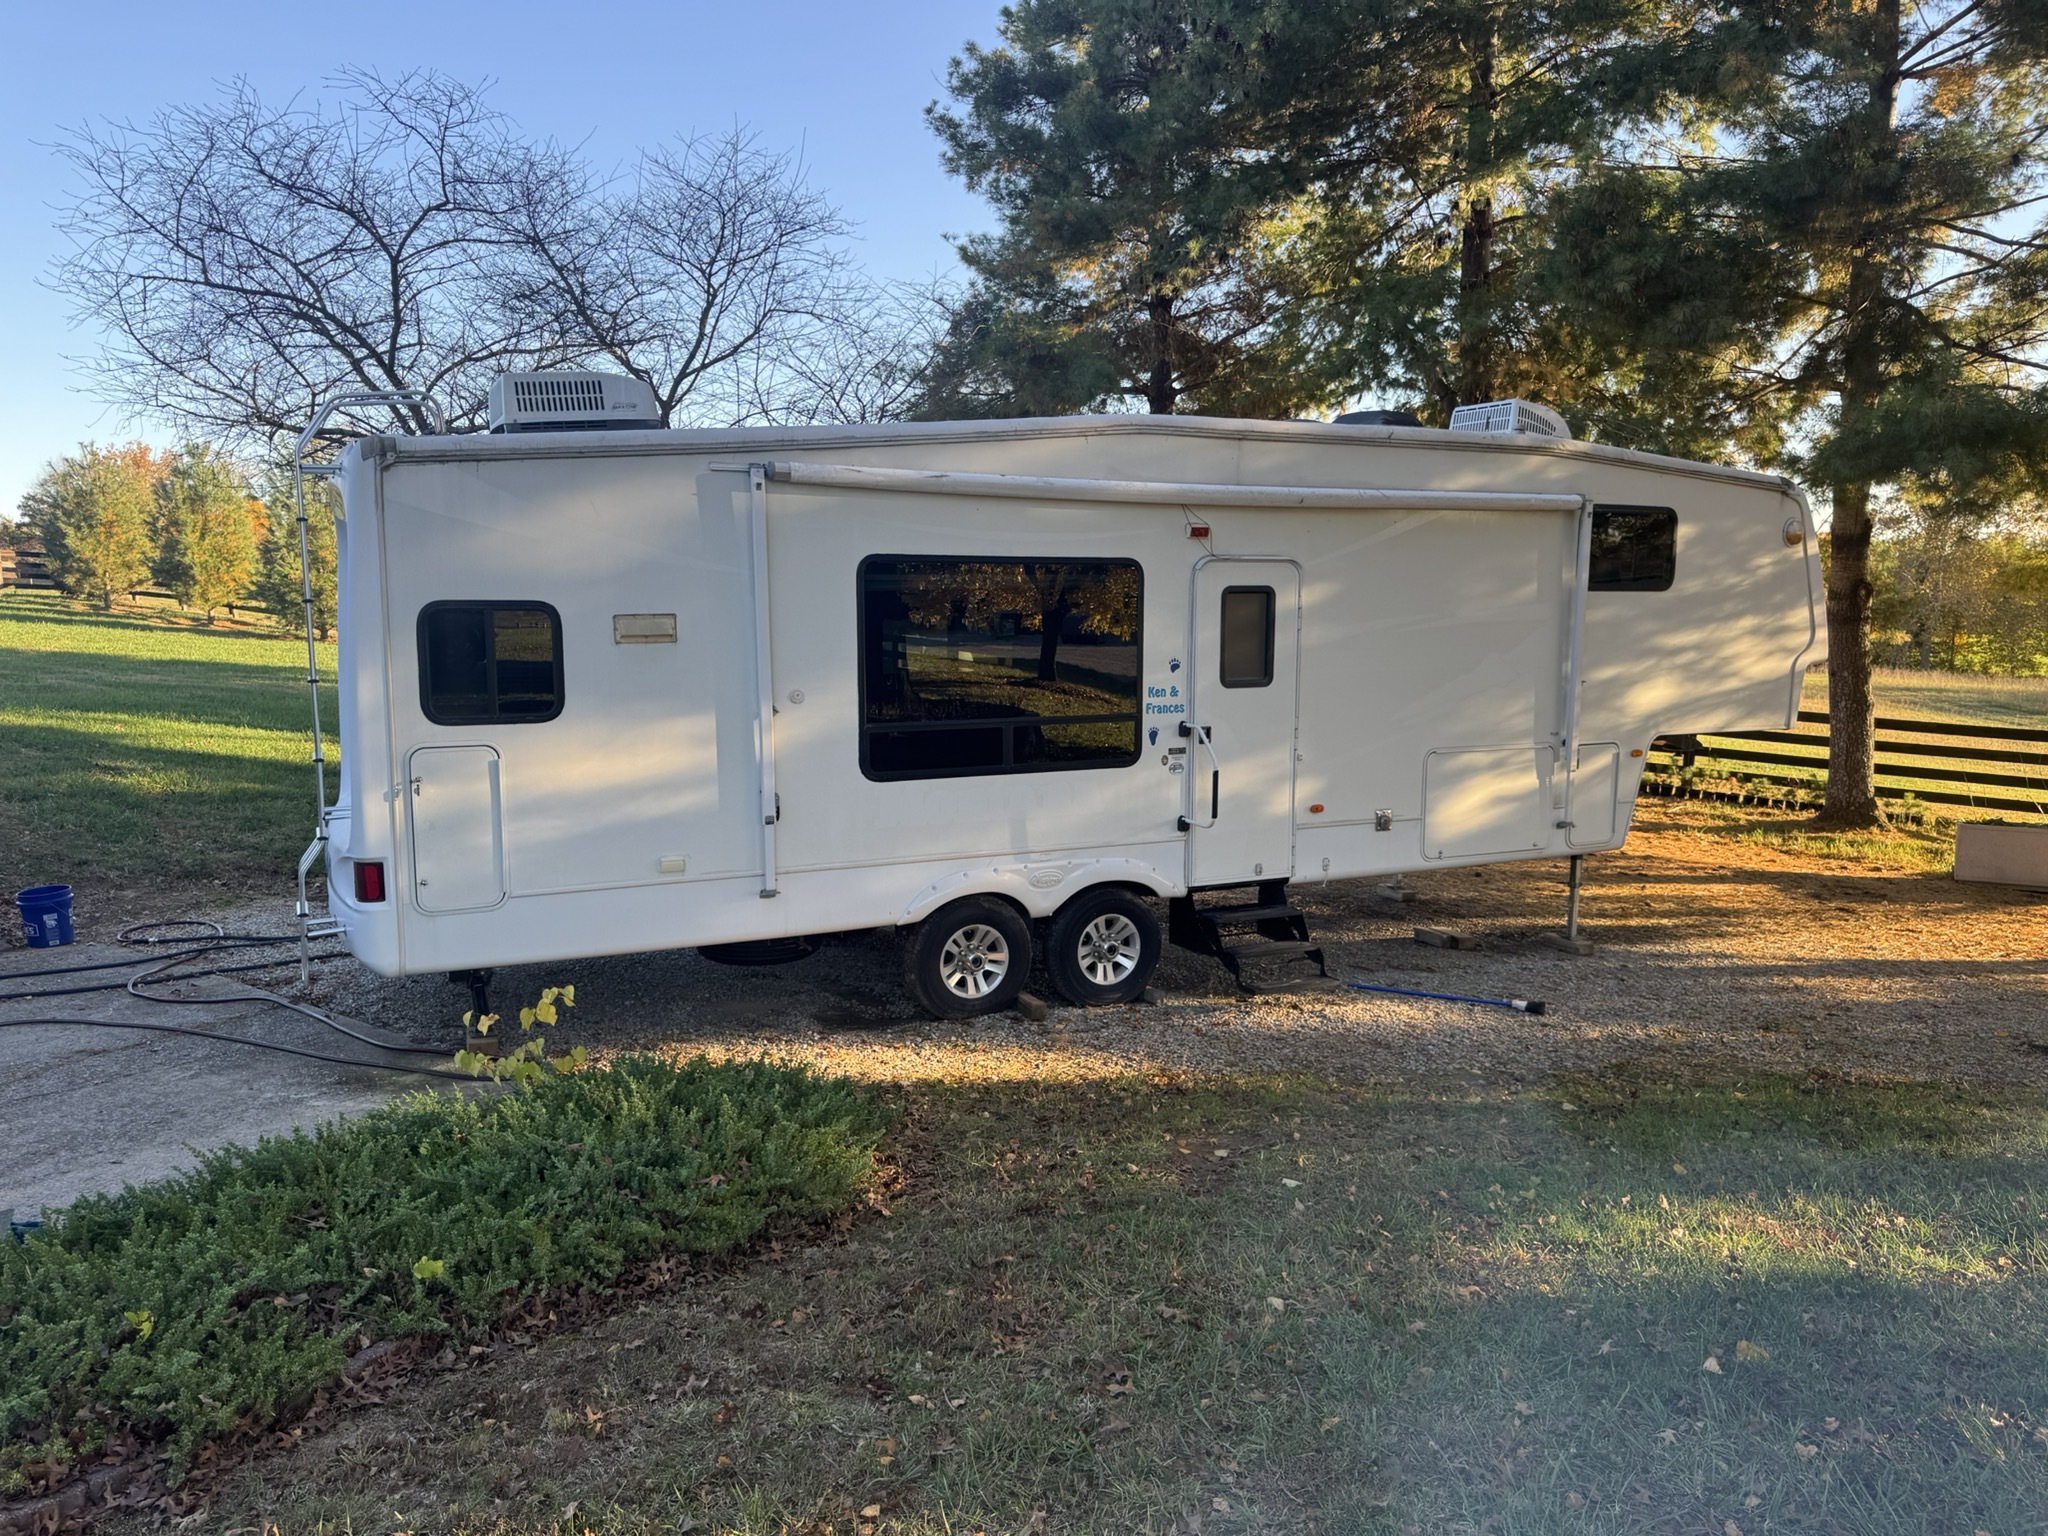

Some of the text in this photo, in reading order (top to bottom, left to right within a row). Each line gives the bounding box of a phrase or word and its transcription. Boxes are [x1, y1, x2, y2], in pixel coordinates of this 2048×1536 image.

[1148, 685, 1179, 698] Ken &
[1145, 703, 1185, 714] Frances
